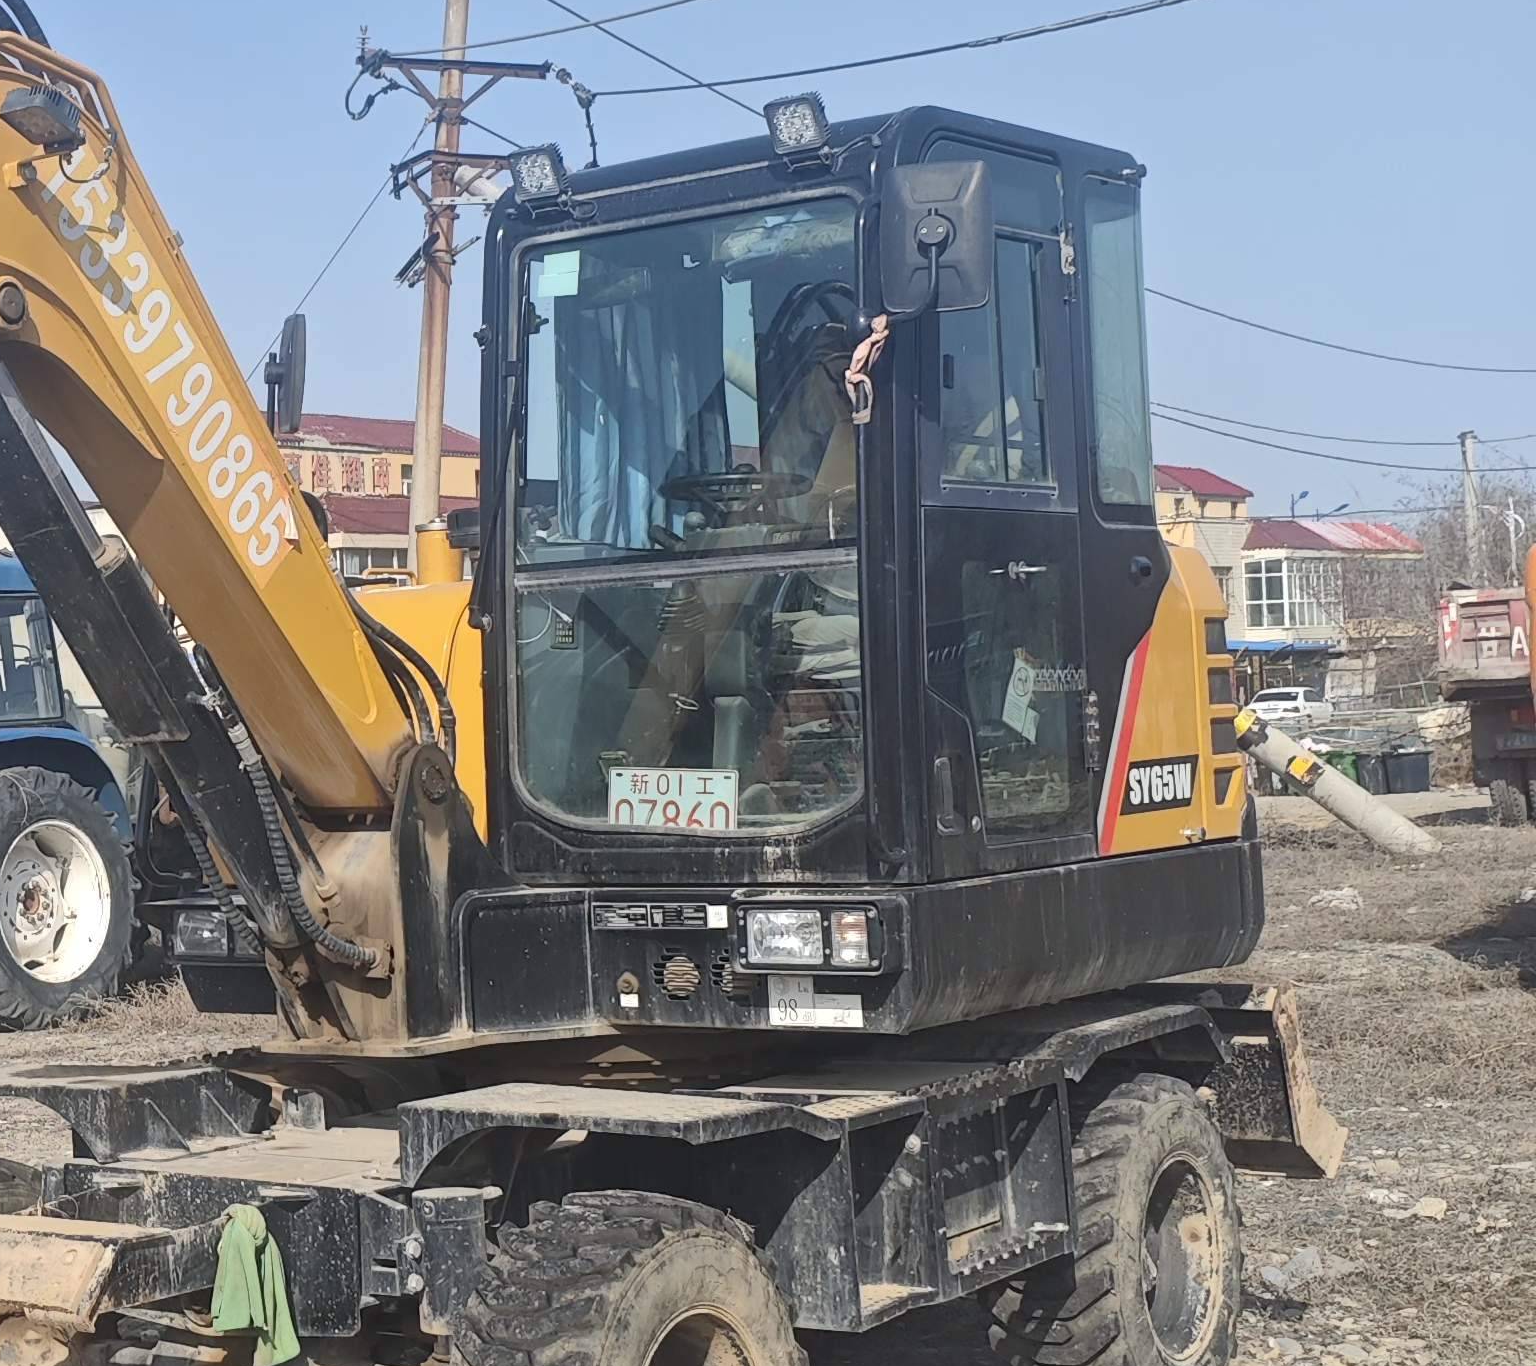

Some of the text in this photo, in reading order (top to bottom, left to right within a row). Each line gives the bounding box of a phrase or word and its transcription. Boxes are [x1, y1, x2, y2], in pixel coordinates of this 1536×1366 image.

[40, 146, 294, 567] 15339790865
[1128, 762, 1192, 805] SY65W
[777, 998, 798, 1021] 98
